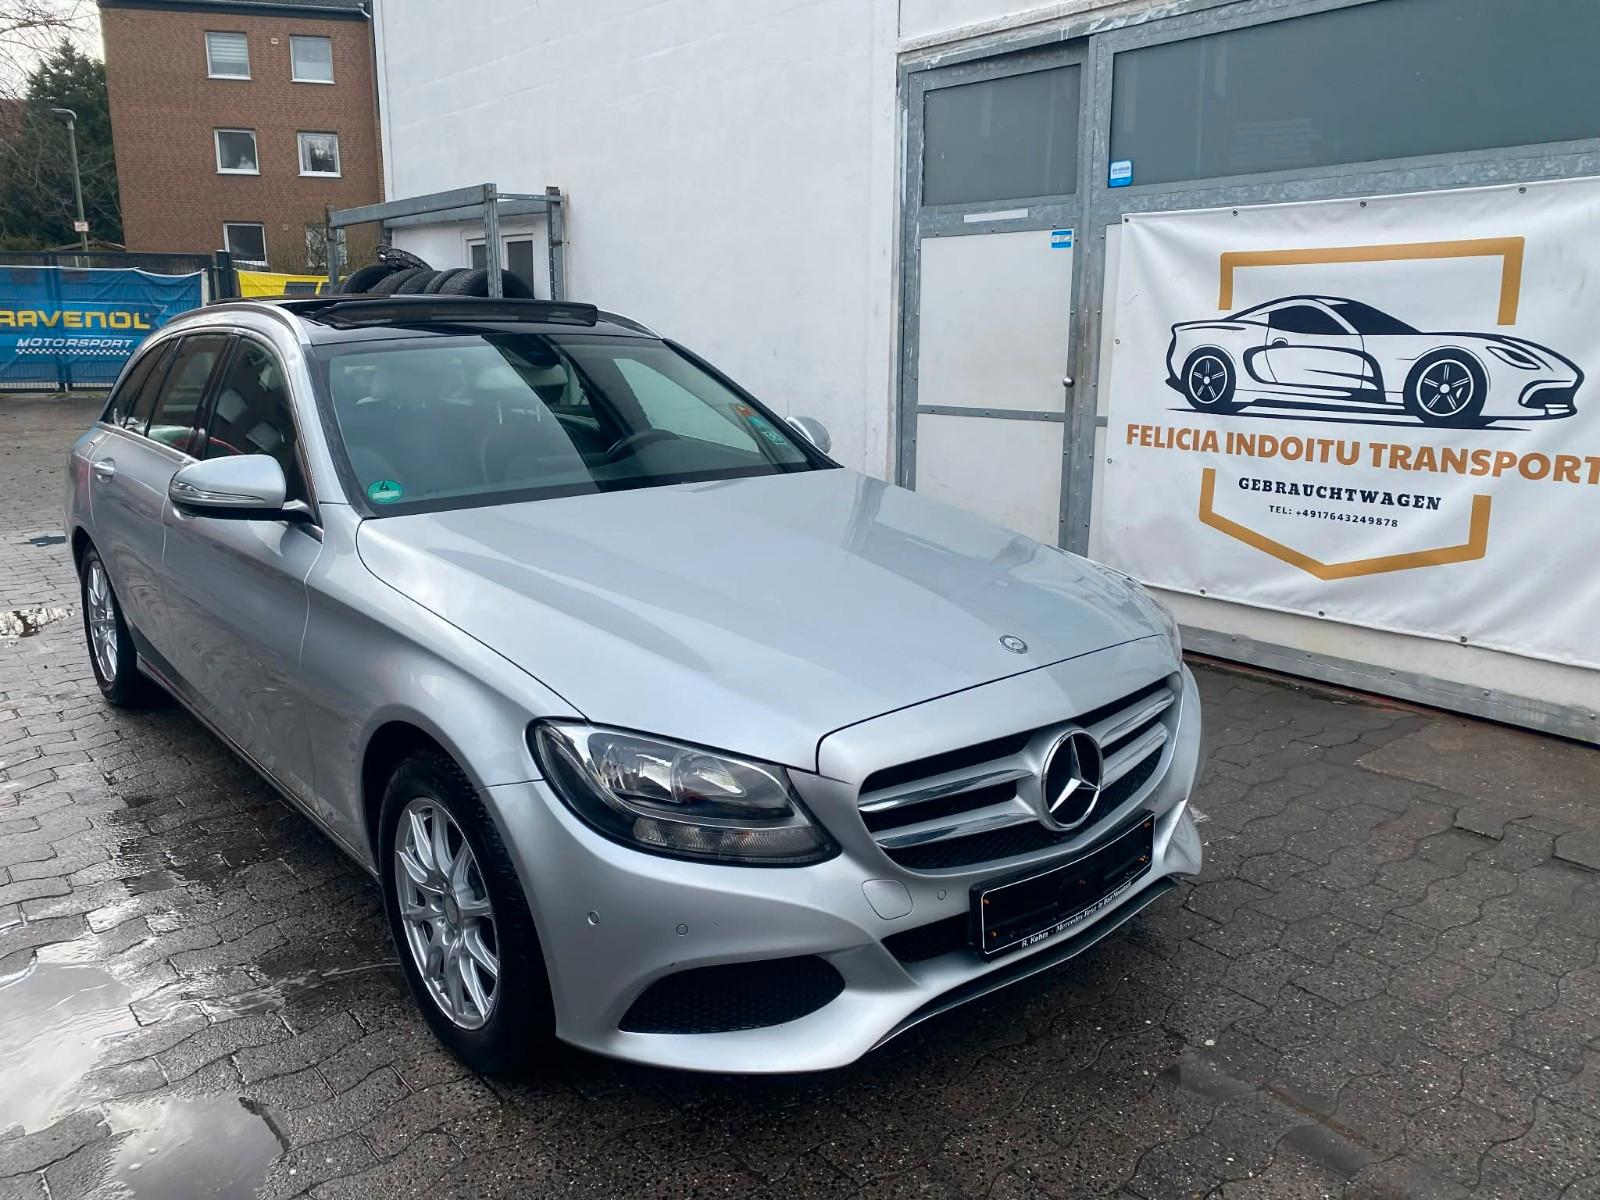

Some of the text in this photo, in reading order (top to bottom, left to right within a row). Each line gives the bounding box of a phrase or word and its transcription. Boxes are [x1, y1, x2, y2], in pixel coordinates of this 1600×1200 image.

[0, 310, 151, 330] RAVENOL
[16, 338, 134, 348] MOTORSPORT
[1126, 423, 1600, 487] FELICIA INDOITU TRANSPORT
[379, 481, 390, 490] 4
[1238, 477, 1441, 511] GEBRAUCHTWAGEN
[1269, 504, 1399, 528] TEL: +4917643249878
